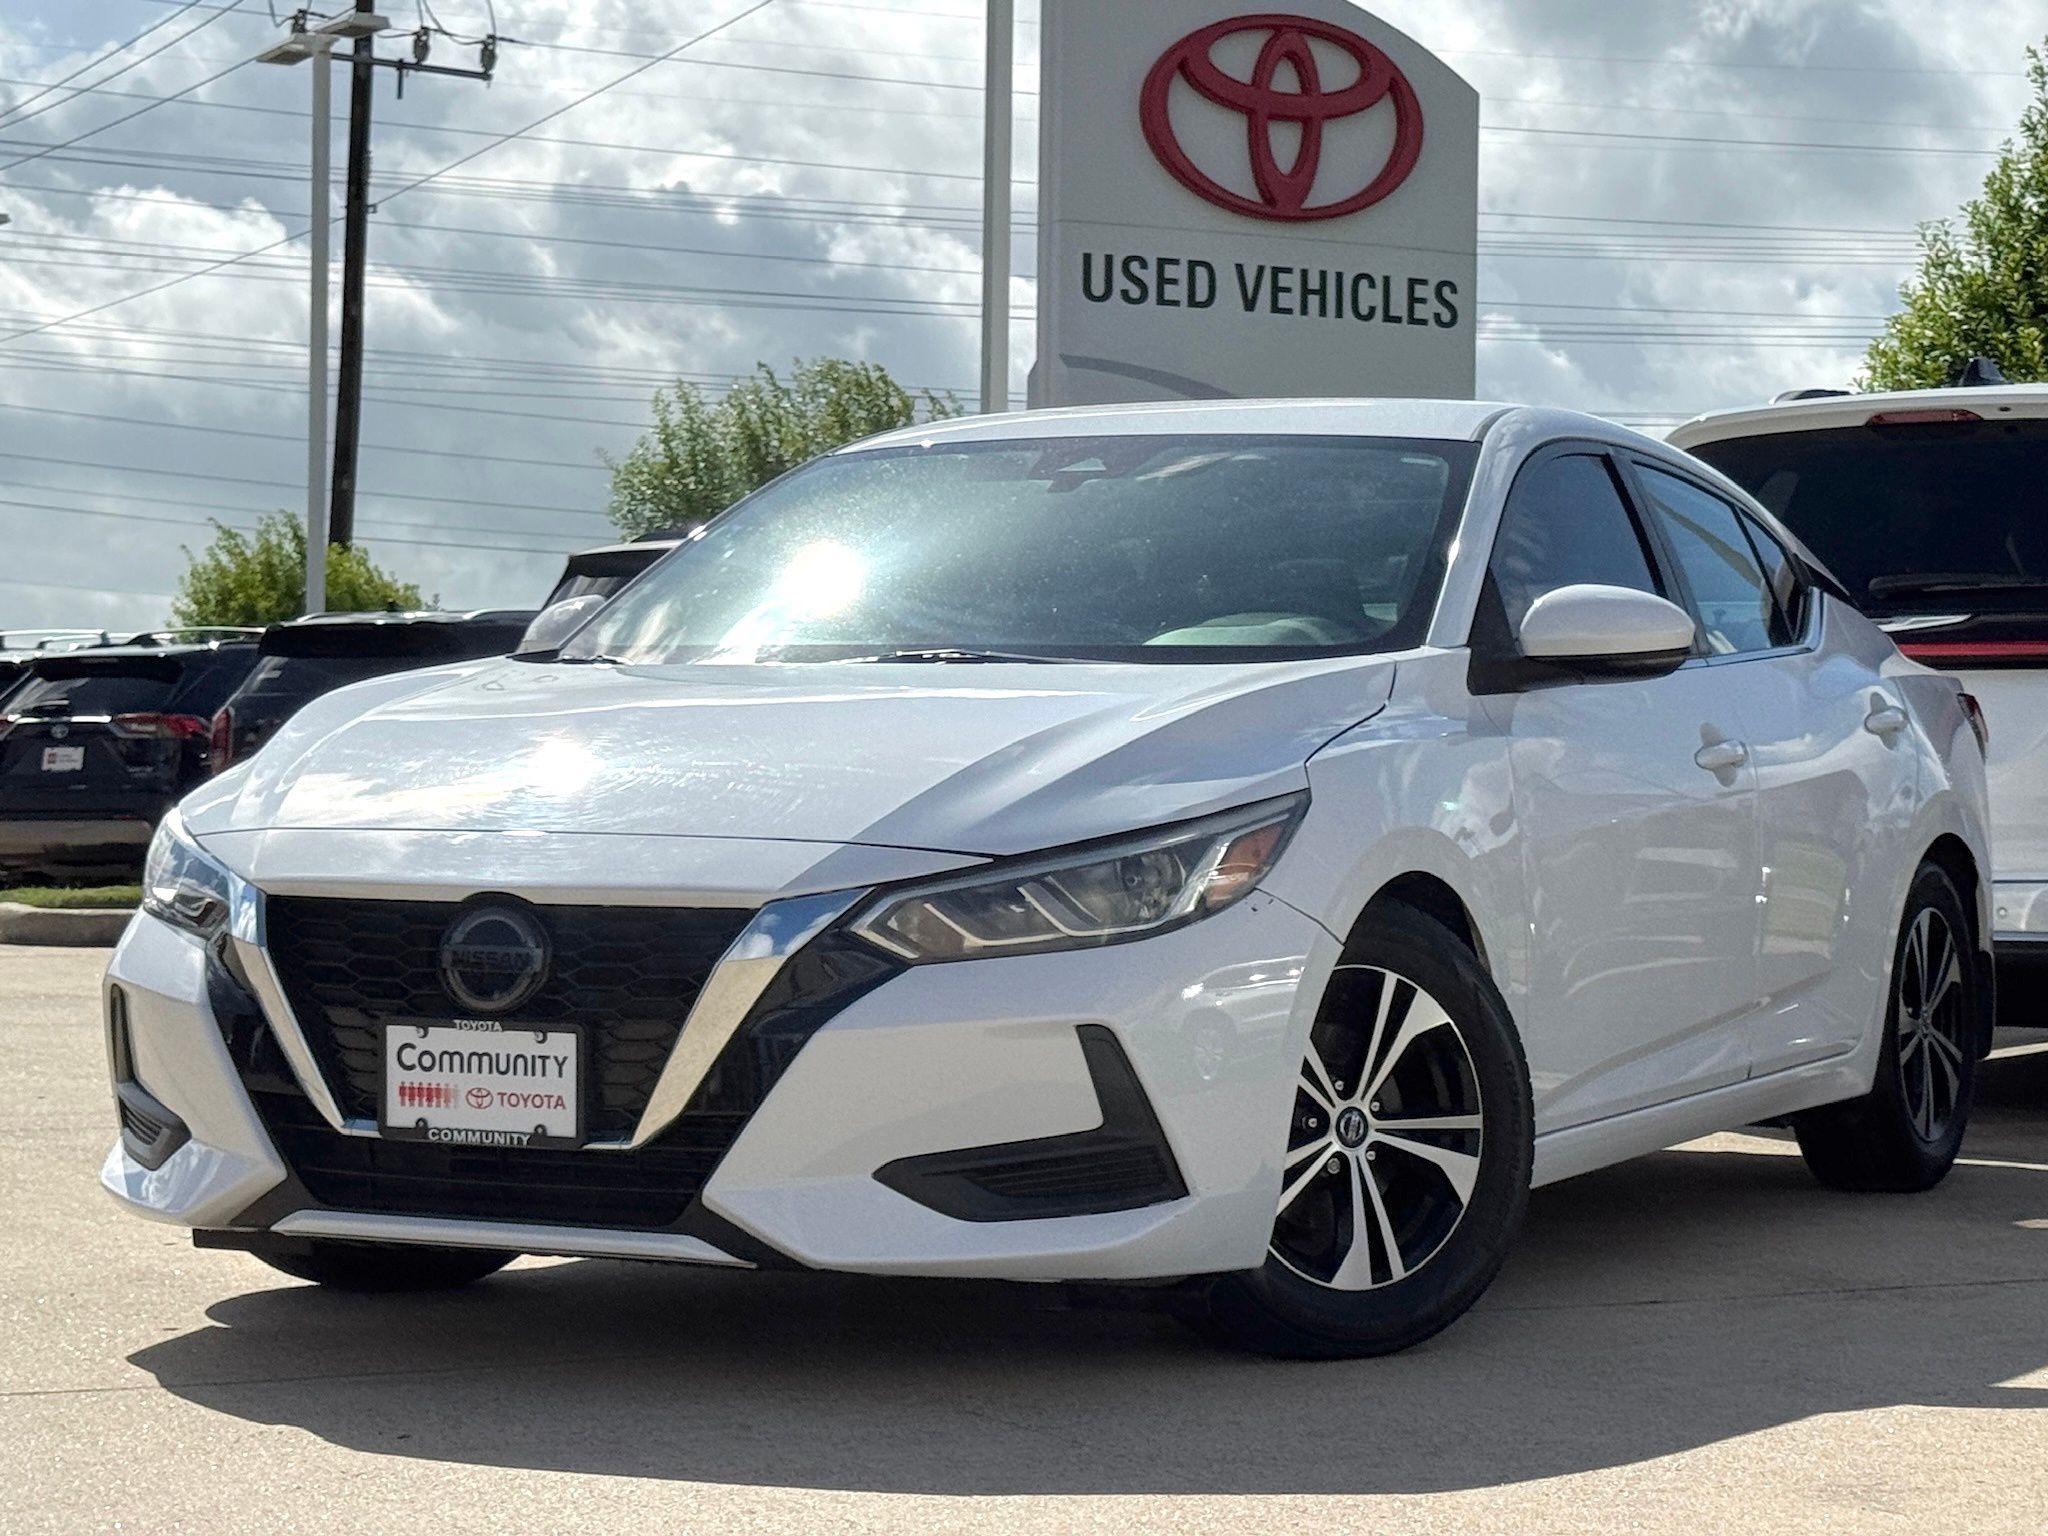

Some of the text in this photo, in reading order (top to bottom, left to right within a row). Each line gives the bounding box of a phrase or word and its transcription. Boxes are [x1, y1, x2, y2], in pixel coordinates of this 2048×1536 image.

[1082, 252, 1459, 329] USED VEHICLES
[451, 951, 531, 968] NISSAN
[453, 1019, 503, 1032] TOYOTA
[497, 1091, 567, 1110] TOYOTA
[428, 1128, 532, 1146] COMMUNITY
